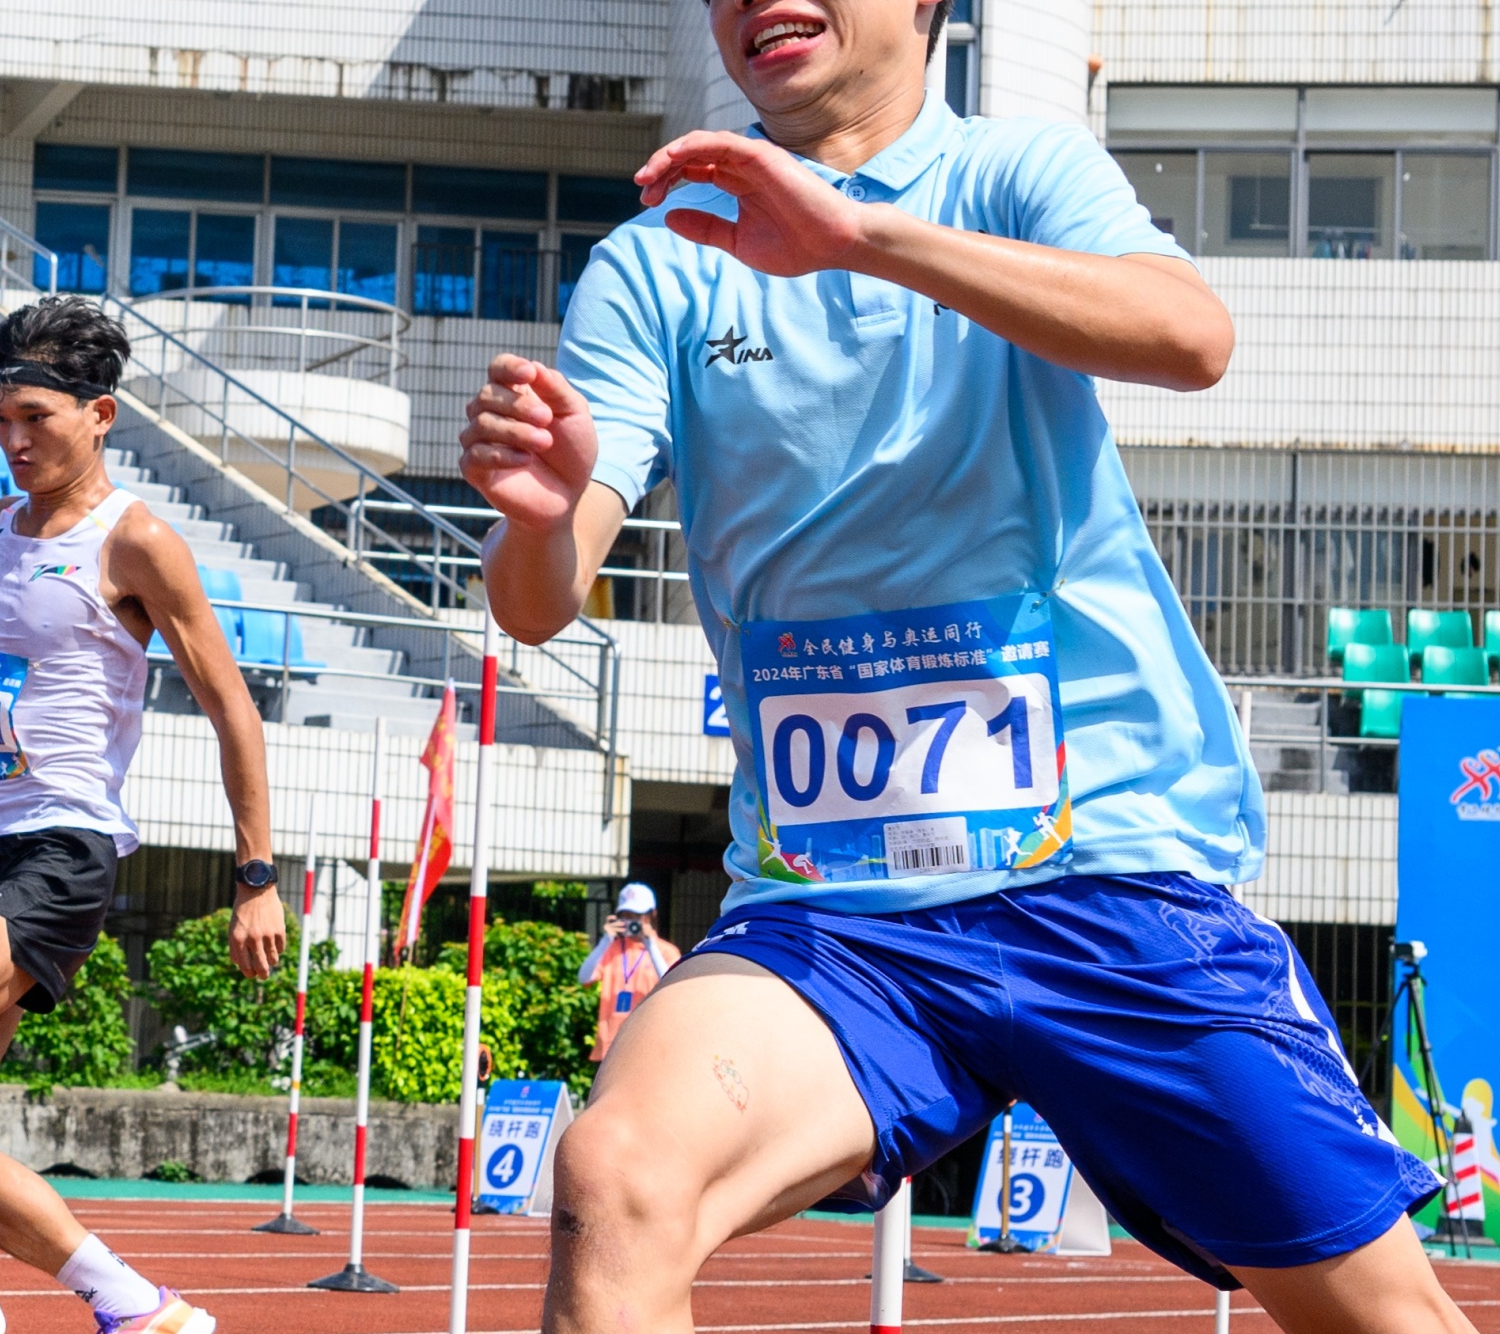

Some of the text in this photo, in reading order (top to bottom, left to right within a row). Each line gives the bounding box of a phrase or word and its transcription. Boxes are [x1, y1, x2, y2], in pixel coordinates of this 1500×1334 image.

[803, 621, 982, 656] 全民健身与奥运同行
[752, 665, 844, 681] 2024年广东省
[1001, 640, 1050, 663] 邀请赛
[771, 695, 1035, 809] 0071
[488, 1119, 542, 1139] 绕杆跑
[491, 1148, 516, 1184] 4
[1008, 1178, 1035, 1217] 3
